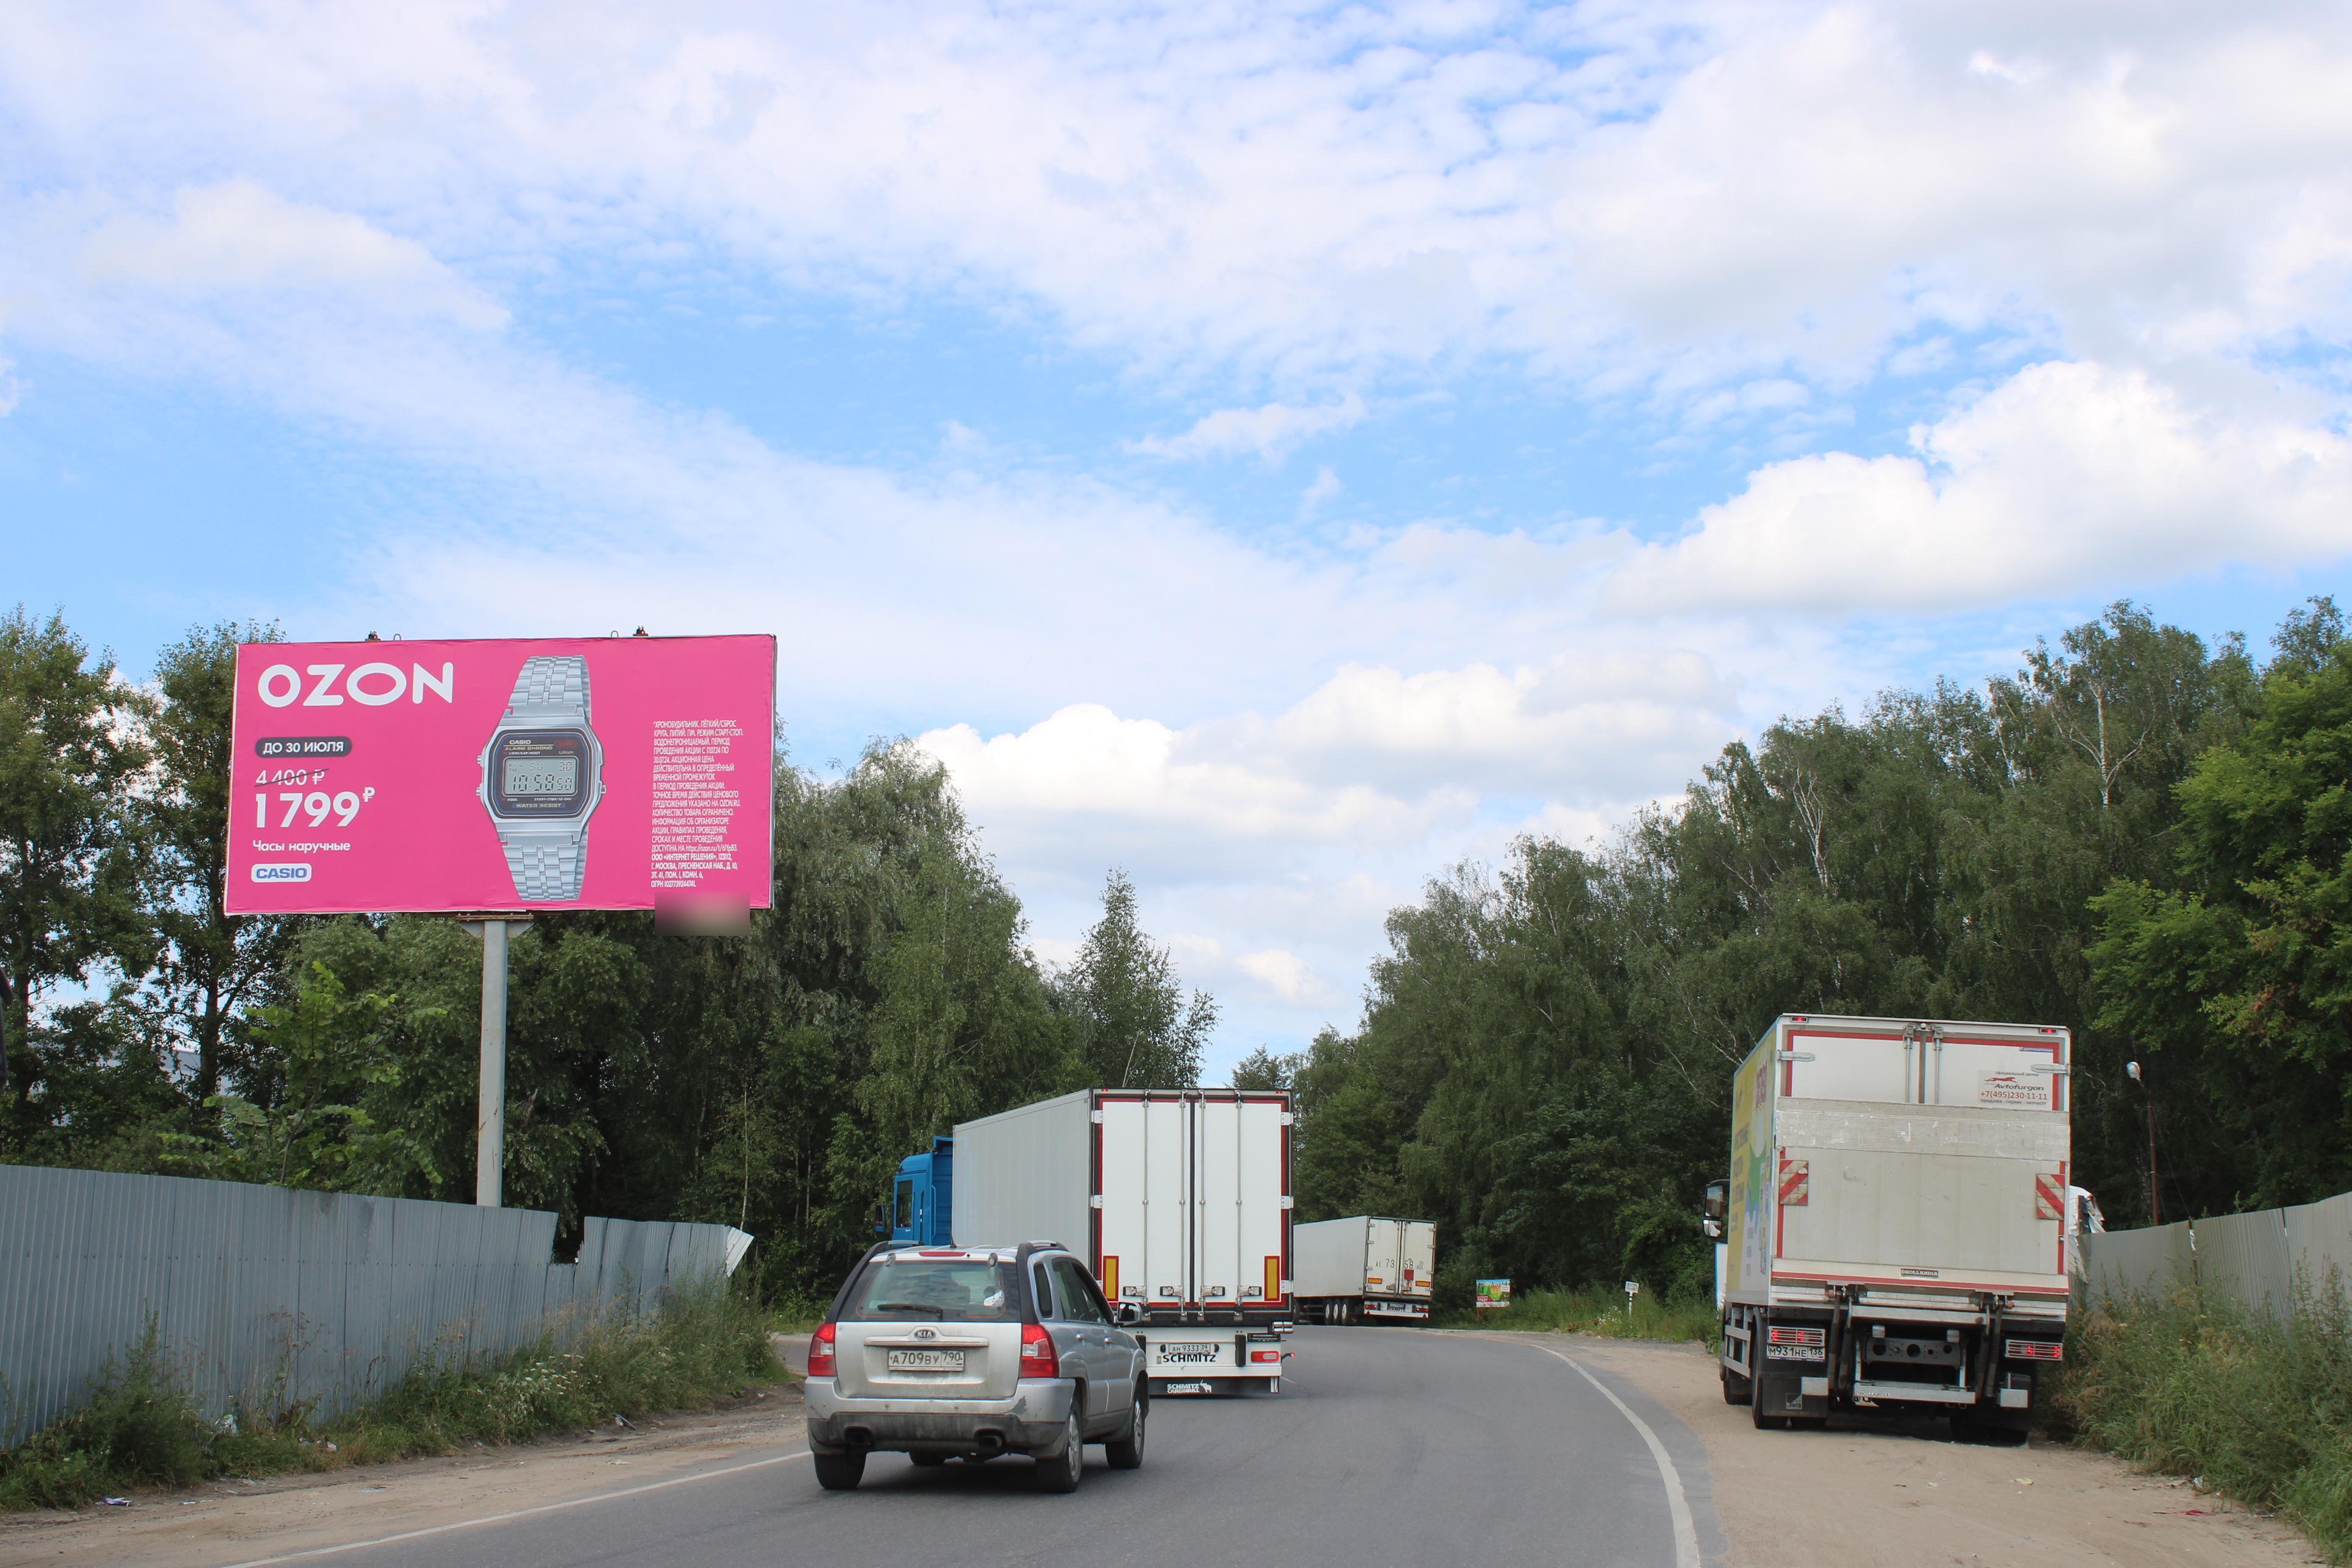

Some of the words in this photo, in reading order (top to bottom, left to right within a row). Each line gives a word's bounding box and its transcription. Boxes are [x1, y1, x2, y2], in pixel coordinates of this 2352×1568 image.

[258, 662, 454, 707] OZON
[263, 743, 283, 755] ДО
[286, 743, 301, 754] 30
[304, 741, 344, 753] ИЮЛЯ
[654, 764, 691, 772] ДЕЙСТВИТЕЛЬНА
[697, 763, 734, 772] ОПРЕДЕЛЁННЫЙ
[255, 770, 267, 785] 4
[273, 769, 307, 786] 400
[513, 774, 555, 791] 10:58
[688, 790, 711, 799] ДЕЙСТВИЯ
[253, 840, 285, 852] Часы
[289, 841, 351, 853] наручные
[256, 868, 307, 878] CASIO
[1981, 1091, 2047, 1100] +7(495)230-11-11
[943, 1352, 961, 1361] 790
